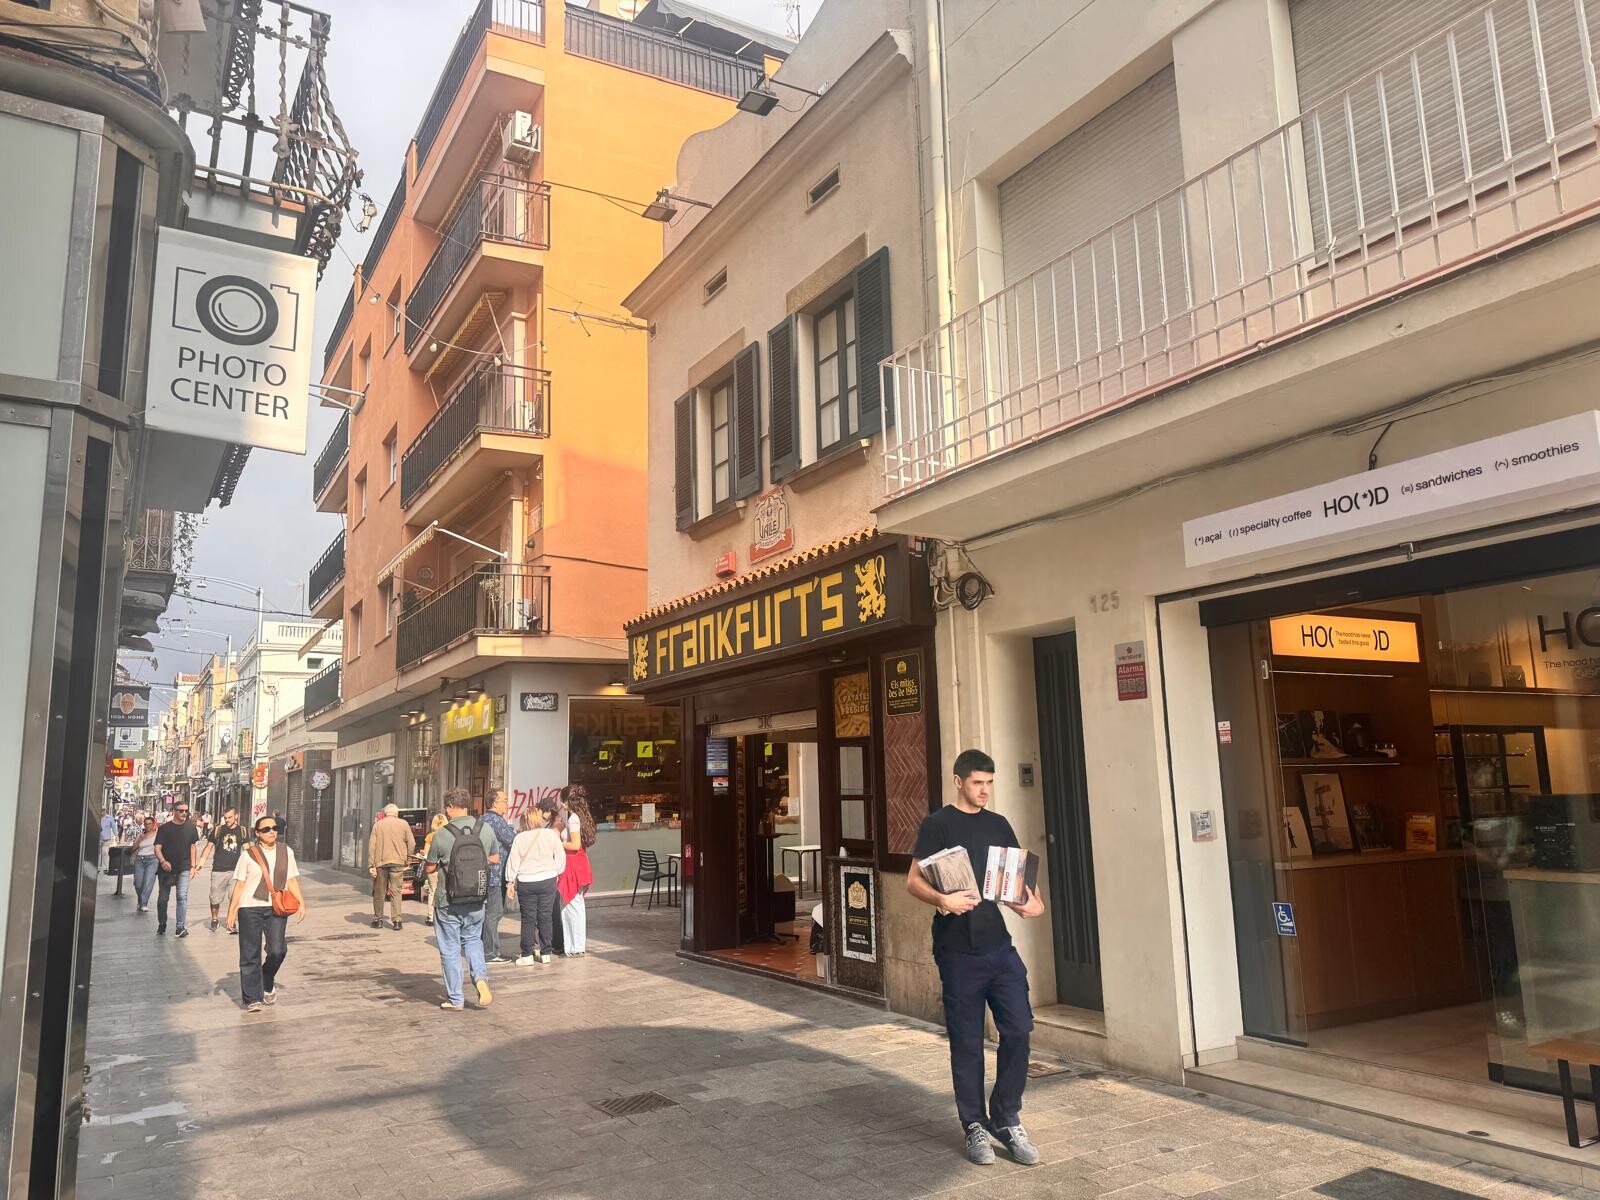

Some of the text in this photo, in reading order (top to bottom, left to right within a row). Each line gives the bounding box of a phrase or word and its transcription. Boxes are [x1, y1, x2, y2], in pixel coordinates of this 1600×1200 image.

[177, 346, 288, 387] PHOTO
[170, 377, 290, 420] CENTER
[1239, 516, 1281, 535] specialty
[1281, 509, 1313, 525] coffee
[1415, 465, 1483, 491] sandwiches
[1511, 441, 1580, 467] smoothies
[1089, 591, 1120, 614] 125
[1118, 664, 1144, 675] Alarma
